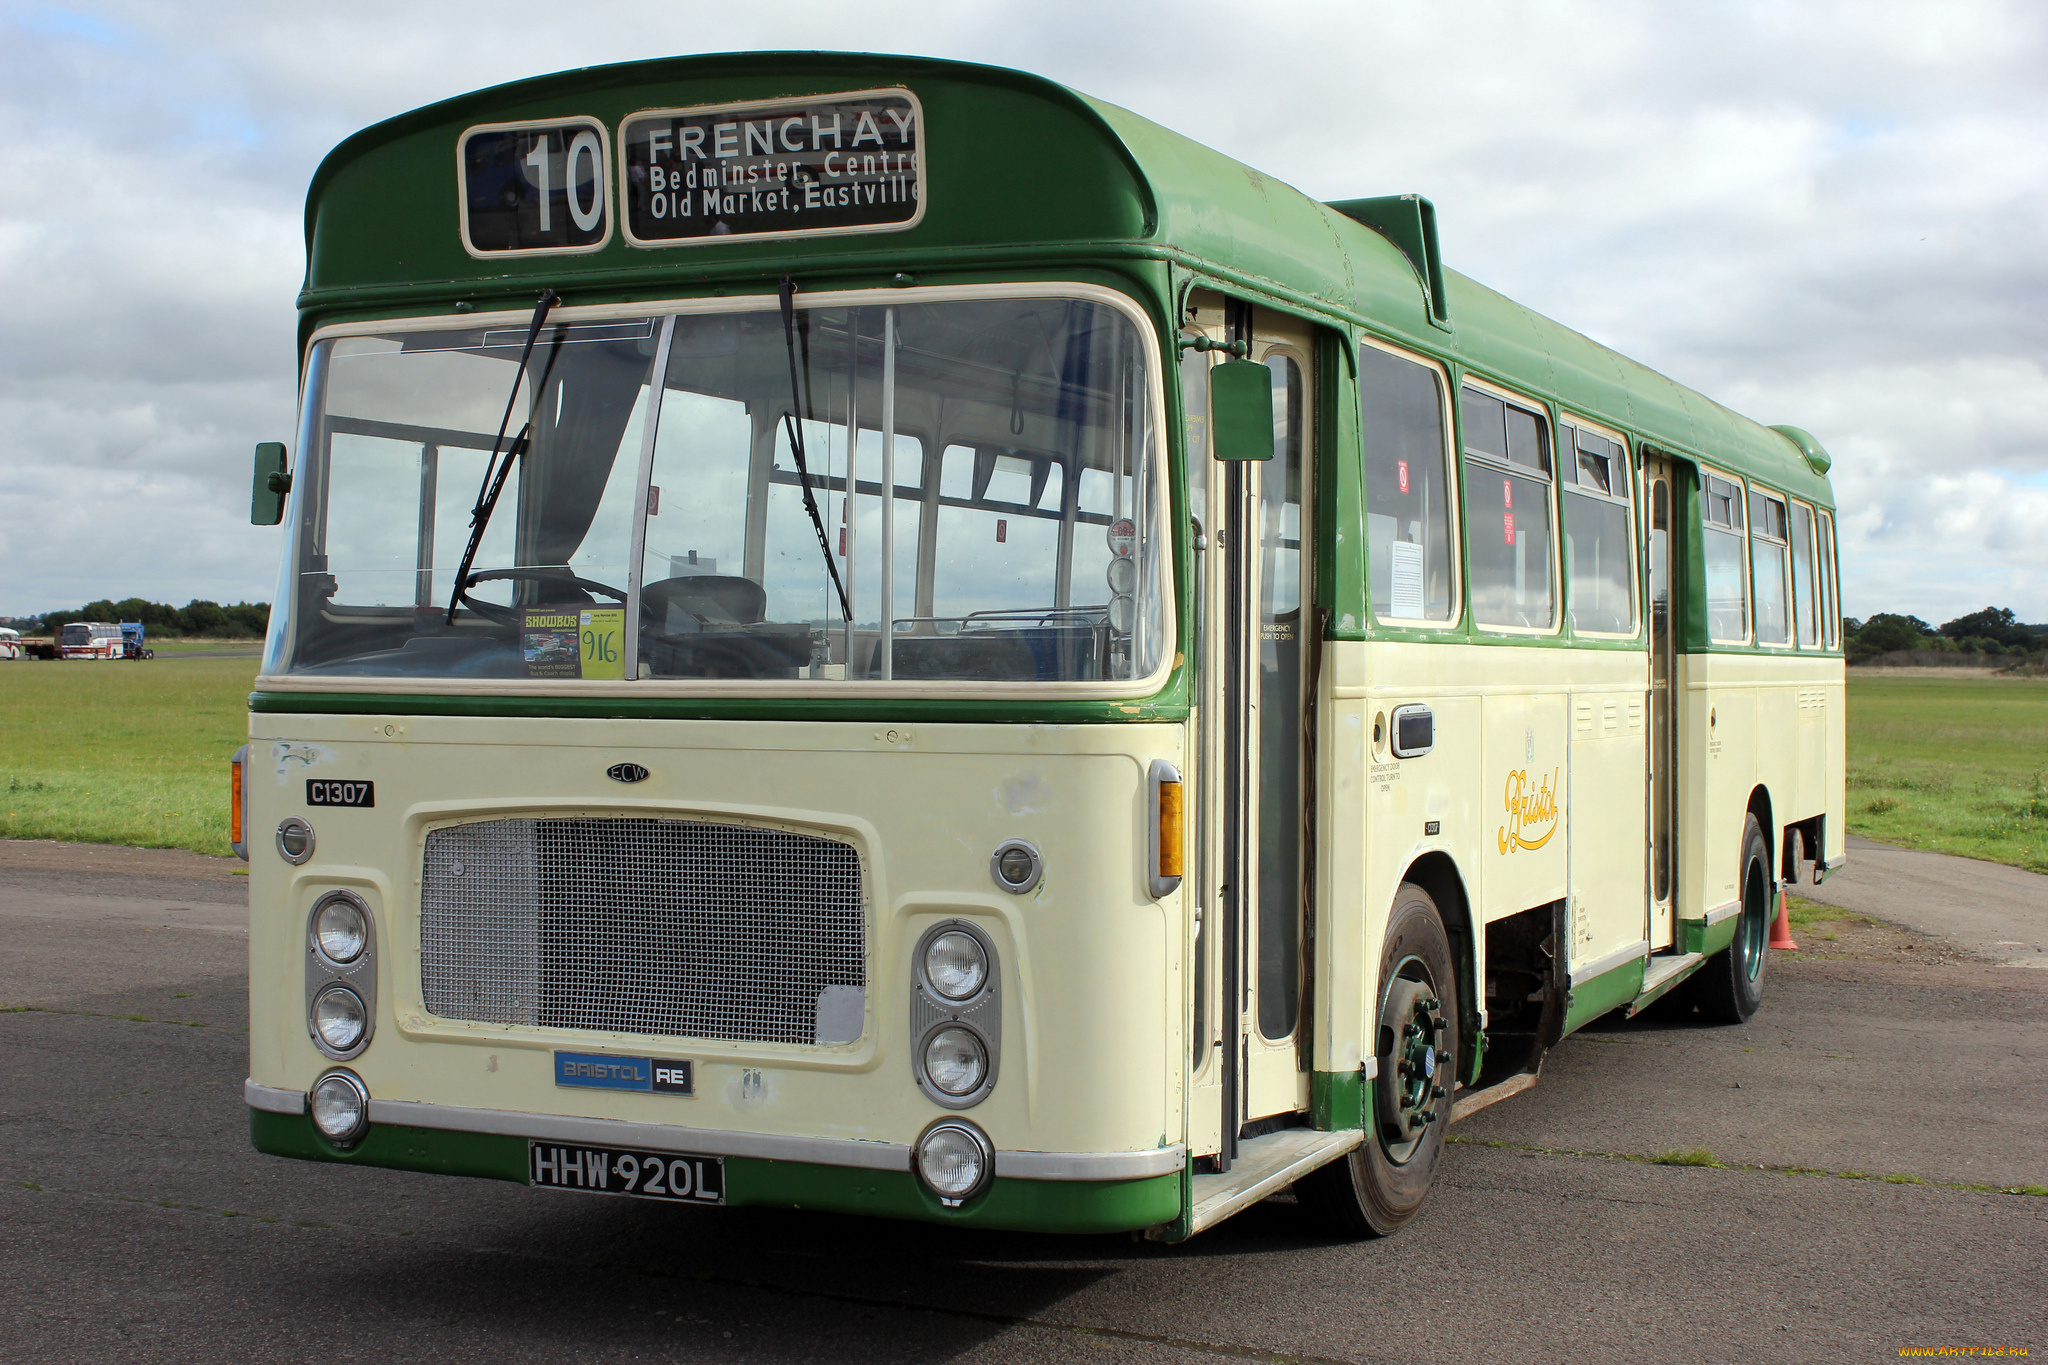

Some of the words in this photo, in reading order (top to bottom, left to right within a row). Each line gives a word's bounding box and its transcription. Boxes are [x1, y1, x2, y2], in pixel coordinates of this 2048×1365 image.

[649, 108, 915, 164] FRENCHAY
[526, 131, 601, 232] 10
[650, 159, 810, 191] Bedminster,
[651, 191, 692, 219] Old
[525, 615, 577, 628] SHOWBUS
[1263, 624, 1292, 632] EMERGENCY
[582, 630, 617, 662] 916
[611, 764, 646, 782] ECW
[312, 782, 368, 803] C1307
[1498, 767, 1558, 855] Bristol
[563, 1061, 645, 1082] BRISTOL
[656, 1067, 684, 1085] RE
[535, 1146, 609, 1189] HHW
[616, 1154, 719, 1200] 920L
